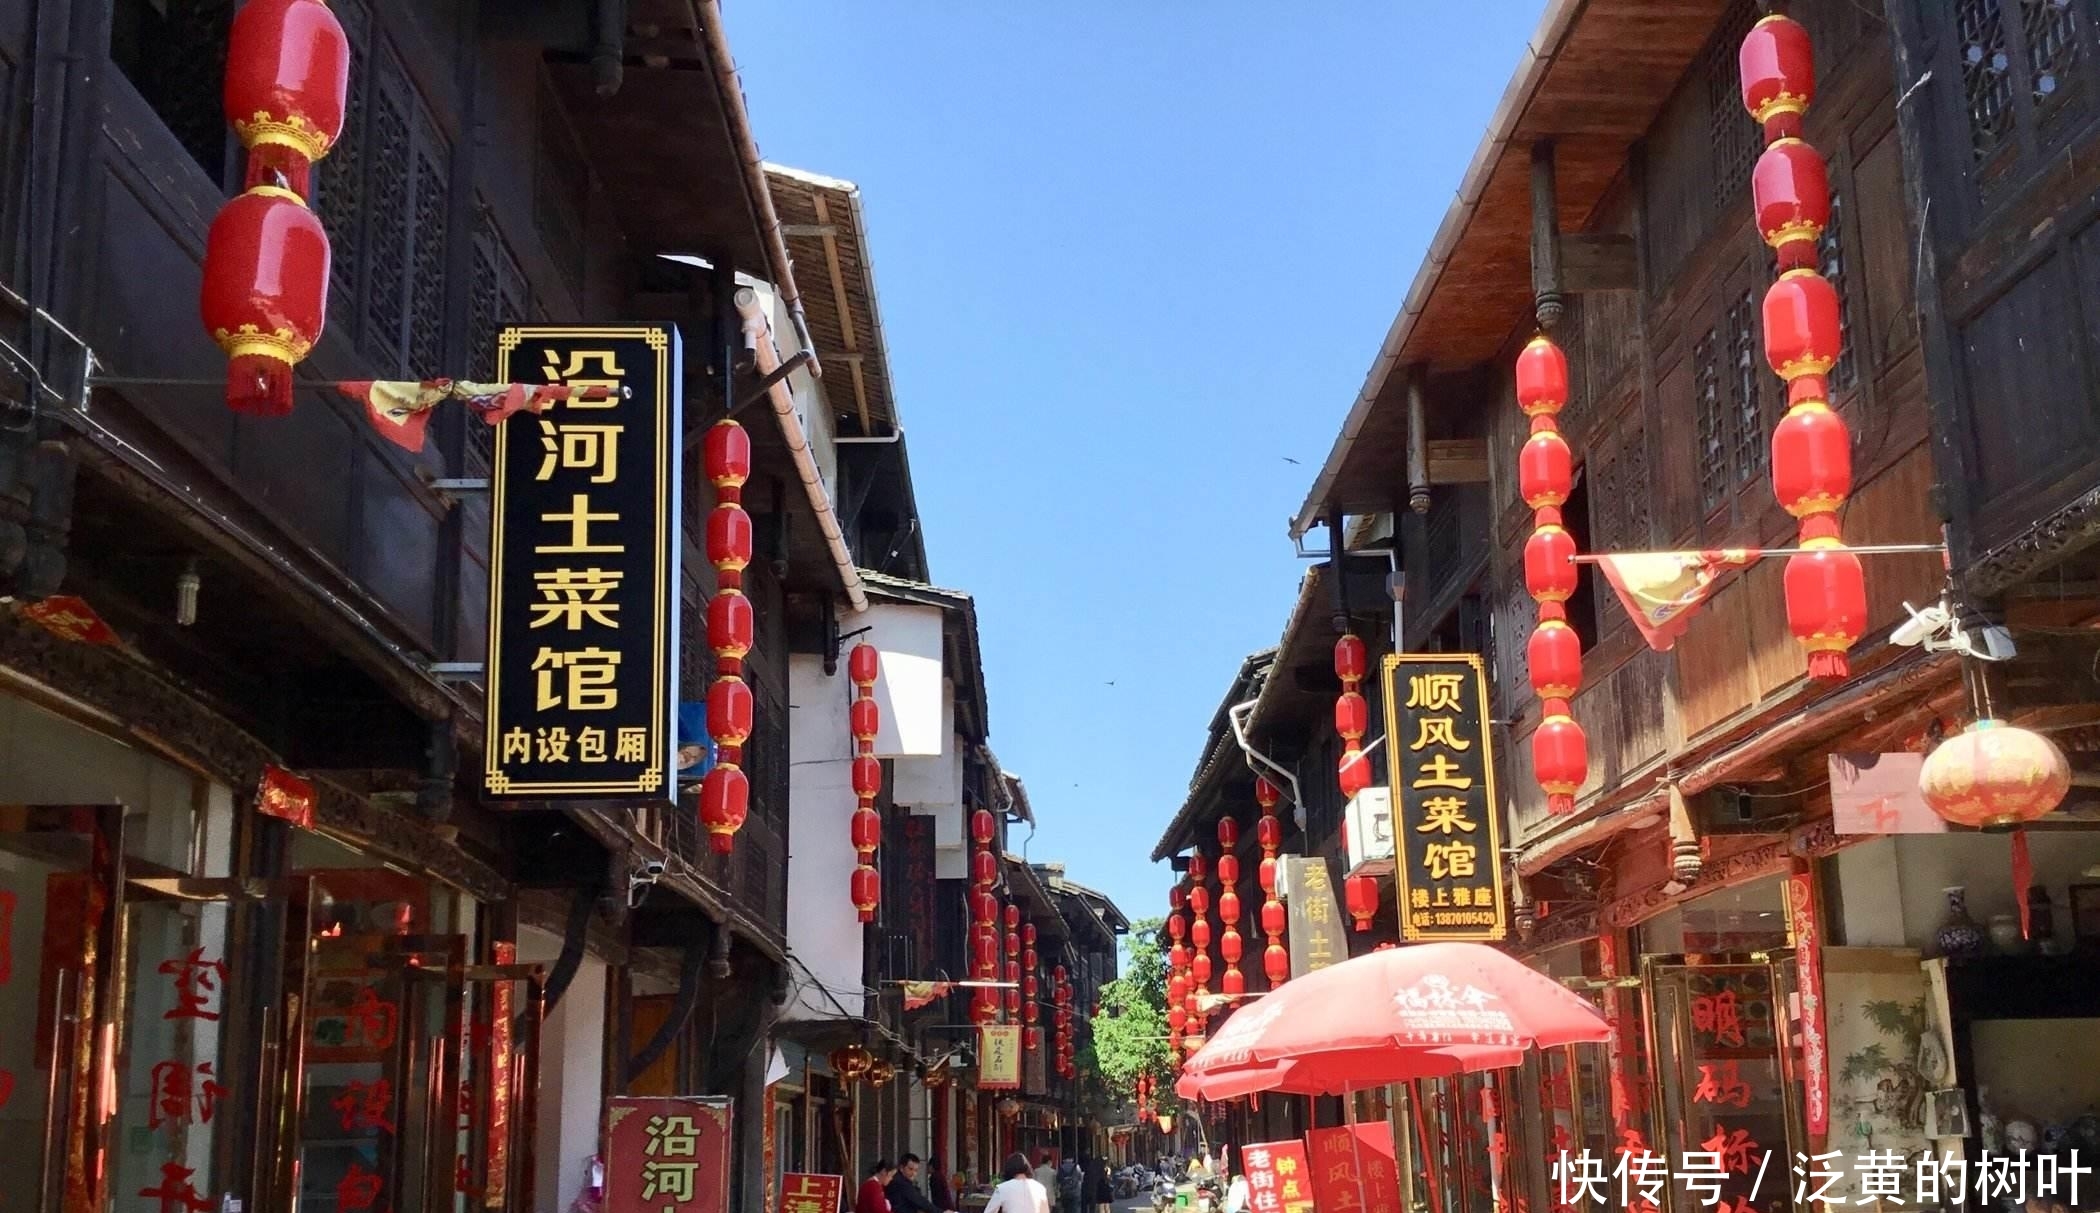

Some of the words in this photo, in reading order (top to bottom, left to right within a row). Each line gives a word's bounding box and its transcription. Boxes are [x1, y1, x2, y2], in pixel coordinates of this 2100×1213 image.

[529, 349, 626, 712] 沿河土菜馆
[503, 726, 648, 764] 内设包厢
[1405, 672, 1477, 880] 顺风土菜馆
[1411, 887, 1493, 909] 楼上雅座
[641, 1116, 701, 1213] 沿河
[1248, 1150, 1279, 1213] 老街住
